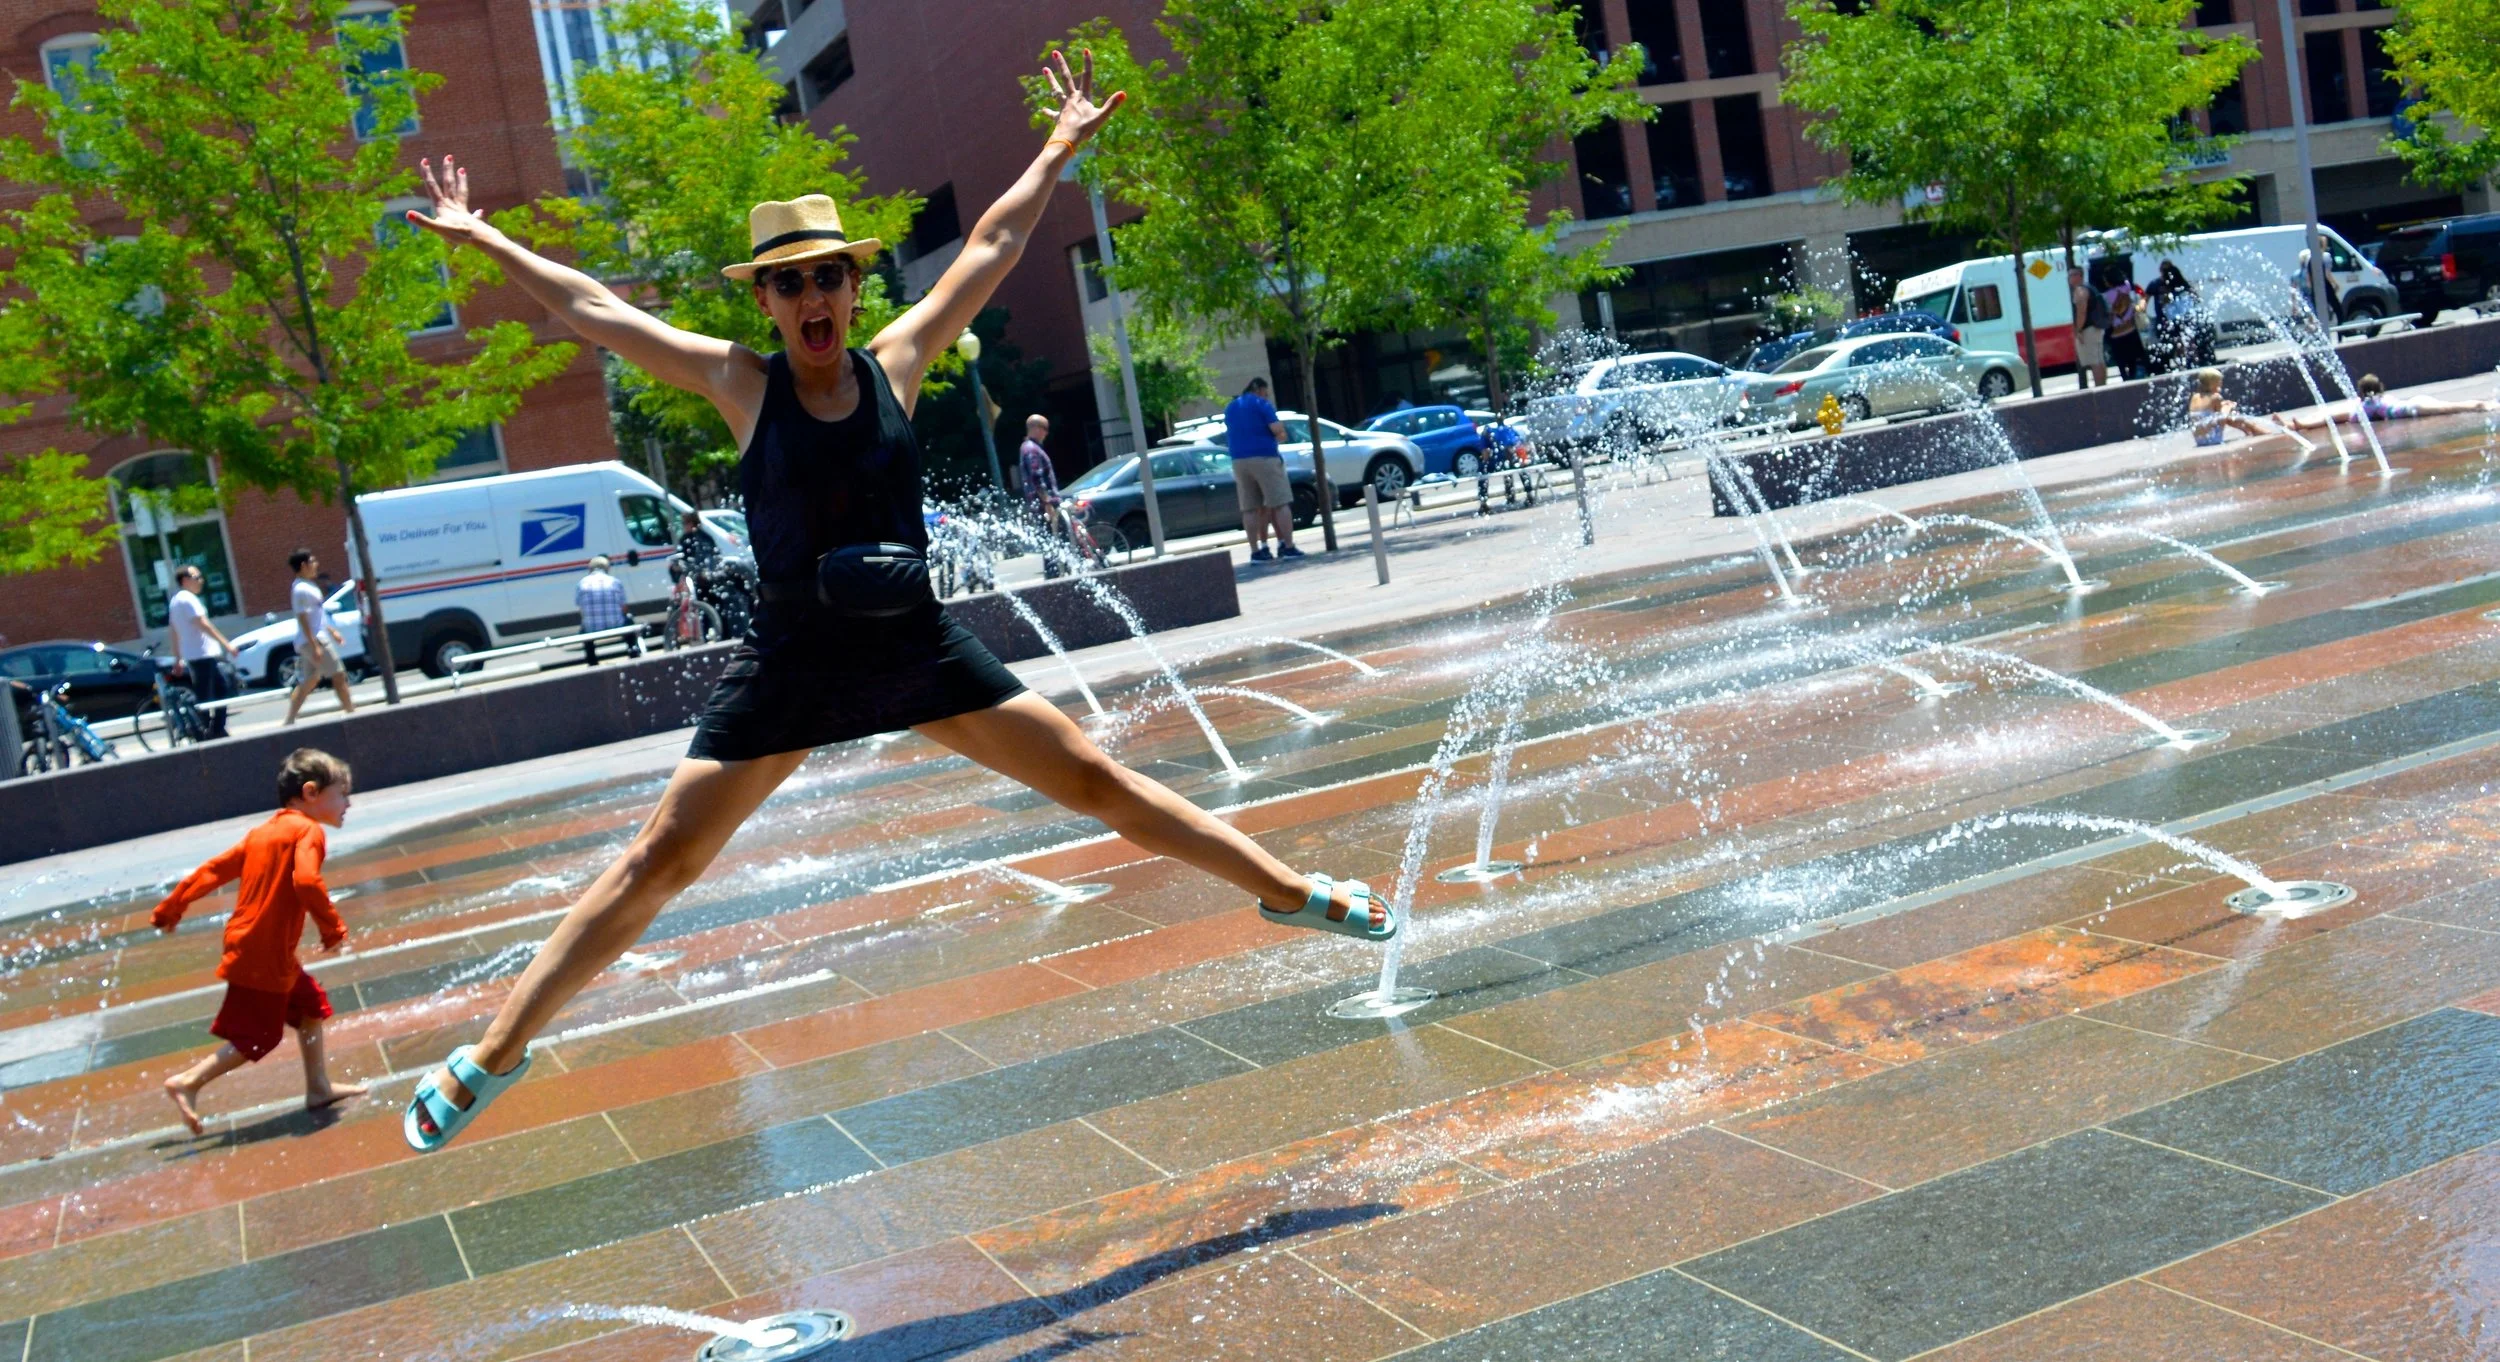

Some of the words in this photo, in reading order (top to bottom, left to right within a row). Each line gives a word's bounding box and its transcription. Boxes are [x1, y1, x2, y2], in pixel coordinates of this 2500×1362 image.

[378, 532, 398, 543] We
[400, 526, 440, 541] Deliver
[443, 522, 462, 535] For
